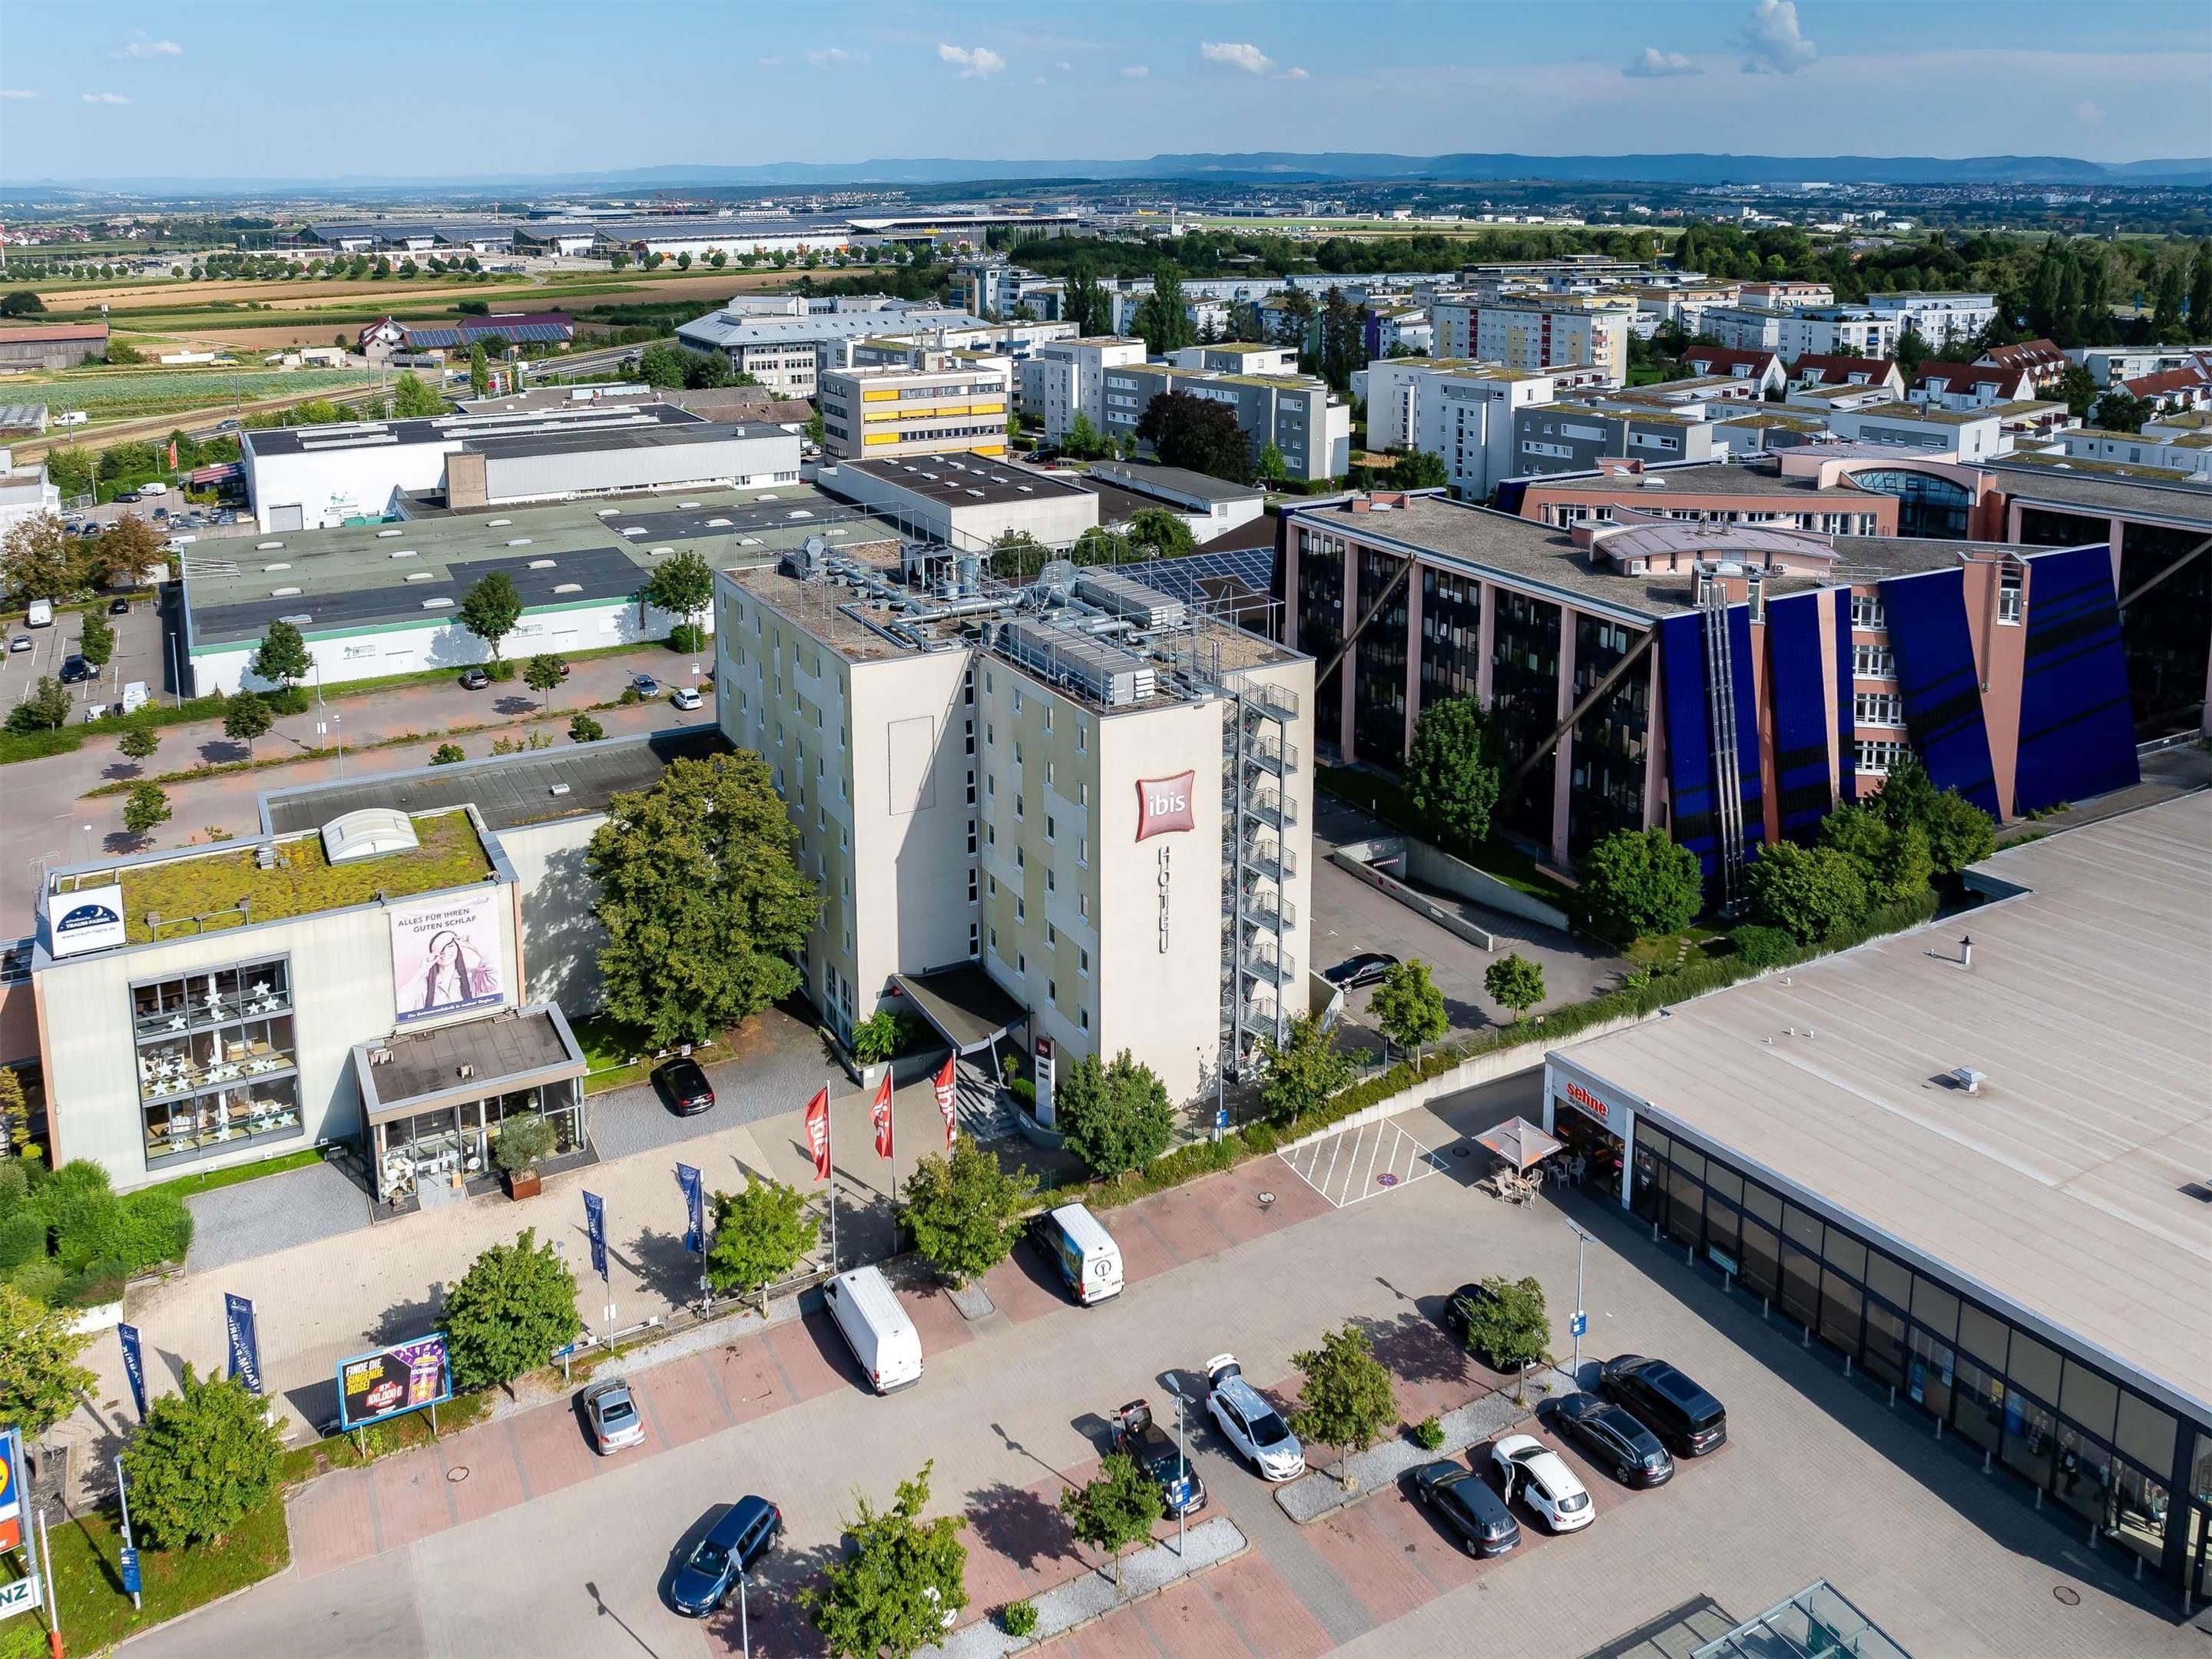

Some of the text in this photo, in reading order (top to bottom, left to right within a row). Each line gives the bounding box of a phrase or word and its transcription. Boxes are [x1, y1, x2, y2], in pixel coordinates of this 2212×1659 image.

[1149, 791, 1186, 817] ibis
[1157, 846, 1171, 954] HOTEL
[398, 908, 470, 927] ALLES FÜR IHREN
[413, 916, 476, 933] GUTEN SCHLAF
[1567, 1081, 1609, 1118] sehne
[346, 1358, 382, 1377] FINDE DIE
[346, 1366, 384, 1386] SINGENDE
[347, 1379, 370, 1396] DOSE!
